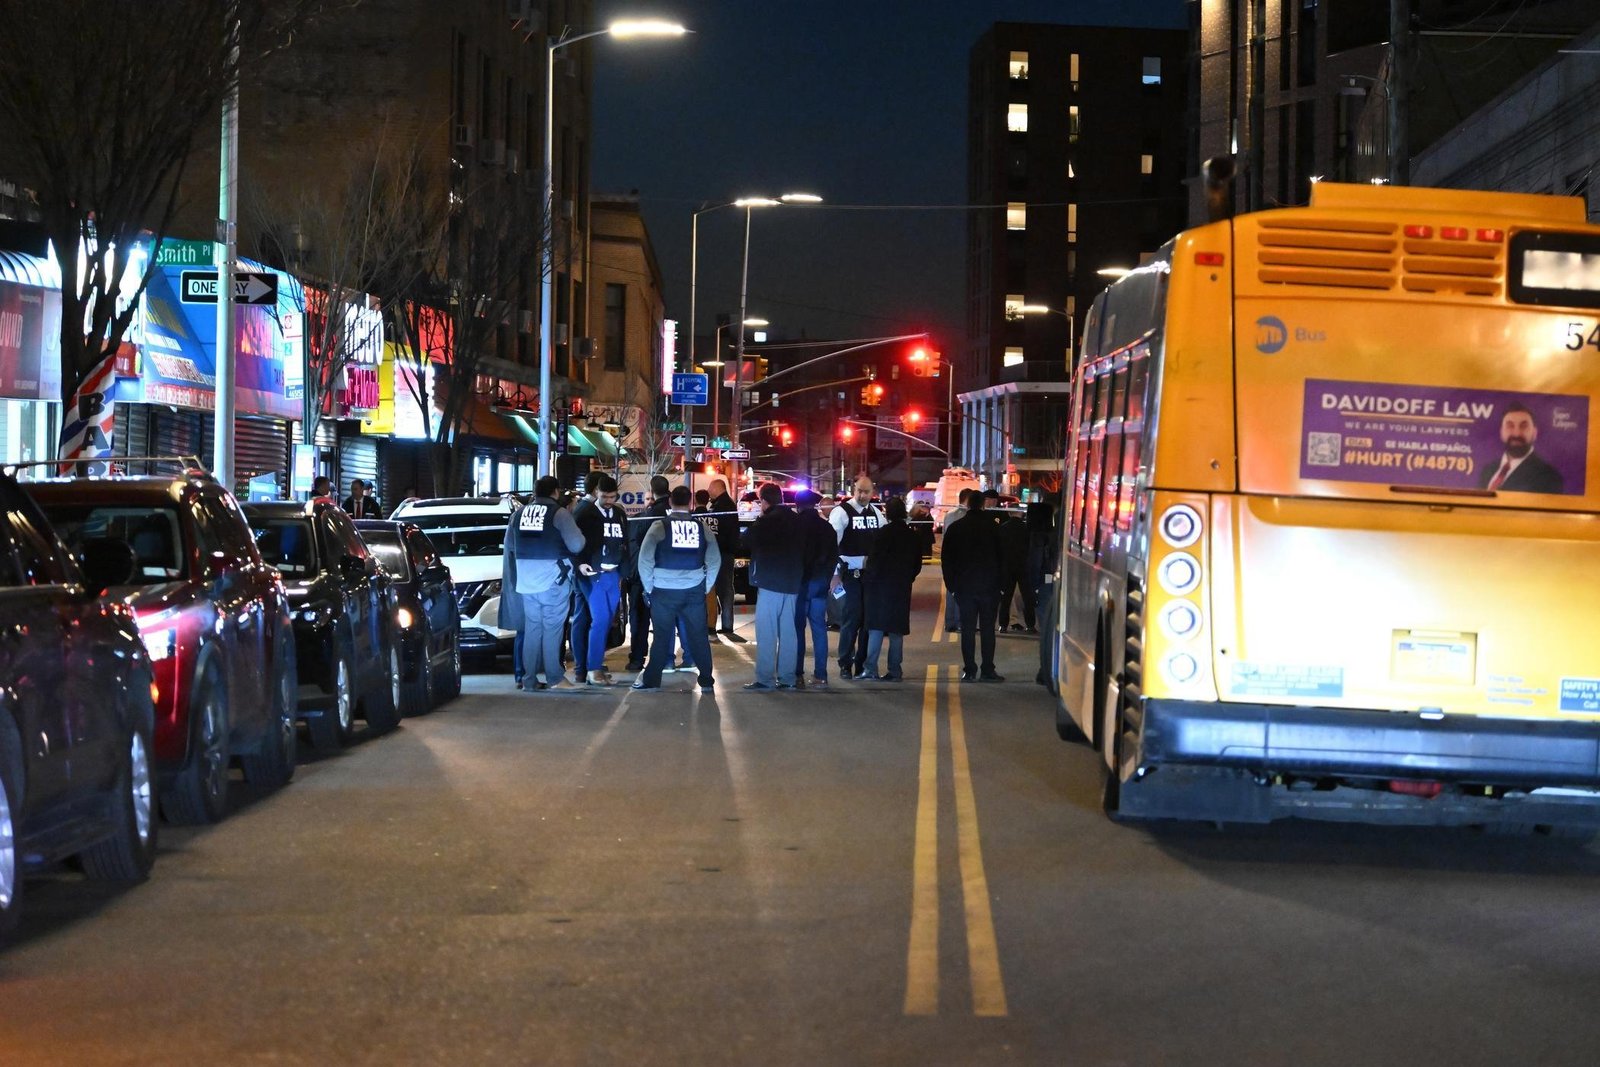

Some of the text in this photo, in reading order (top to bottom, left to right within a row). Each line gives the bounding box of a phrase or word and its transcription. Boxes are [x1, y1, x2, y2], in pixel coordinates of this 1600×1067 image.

[202, 245, 211, 256] Pl
[192, 281, 217, 294] ONE
[1565, 322, 1600, 352] 54
[1321, 393, 1494, 419] DAVIDOFF LAW
[1344, 421, 1470, 436] WE ARE YOUR LAWYERS
[1344, 451, 1474, 475] #HURT (#4878)
[522, 504, 548, 517] NYPD
[520, 515, 545, 527] POLICE
[671, 520, 699, 535] NYPD
[672, 532, 700, 544] POLICE
